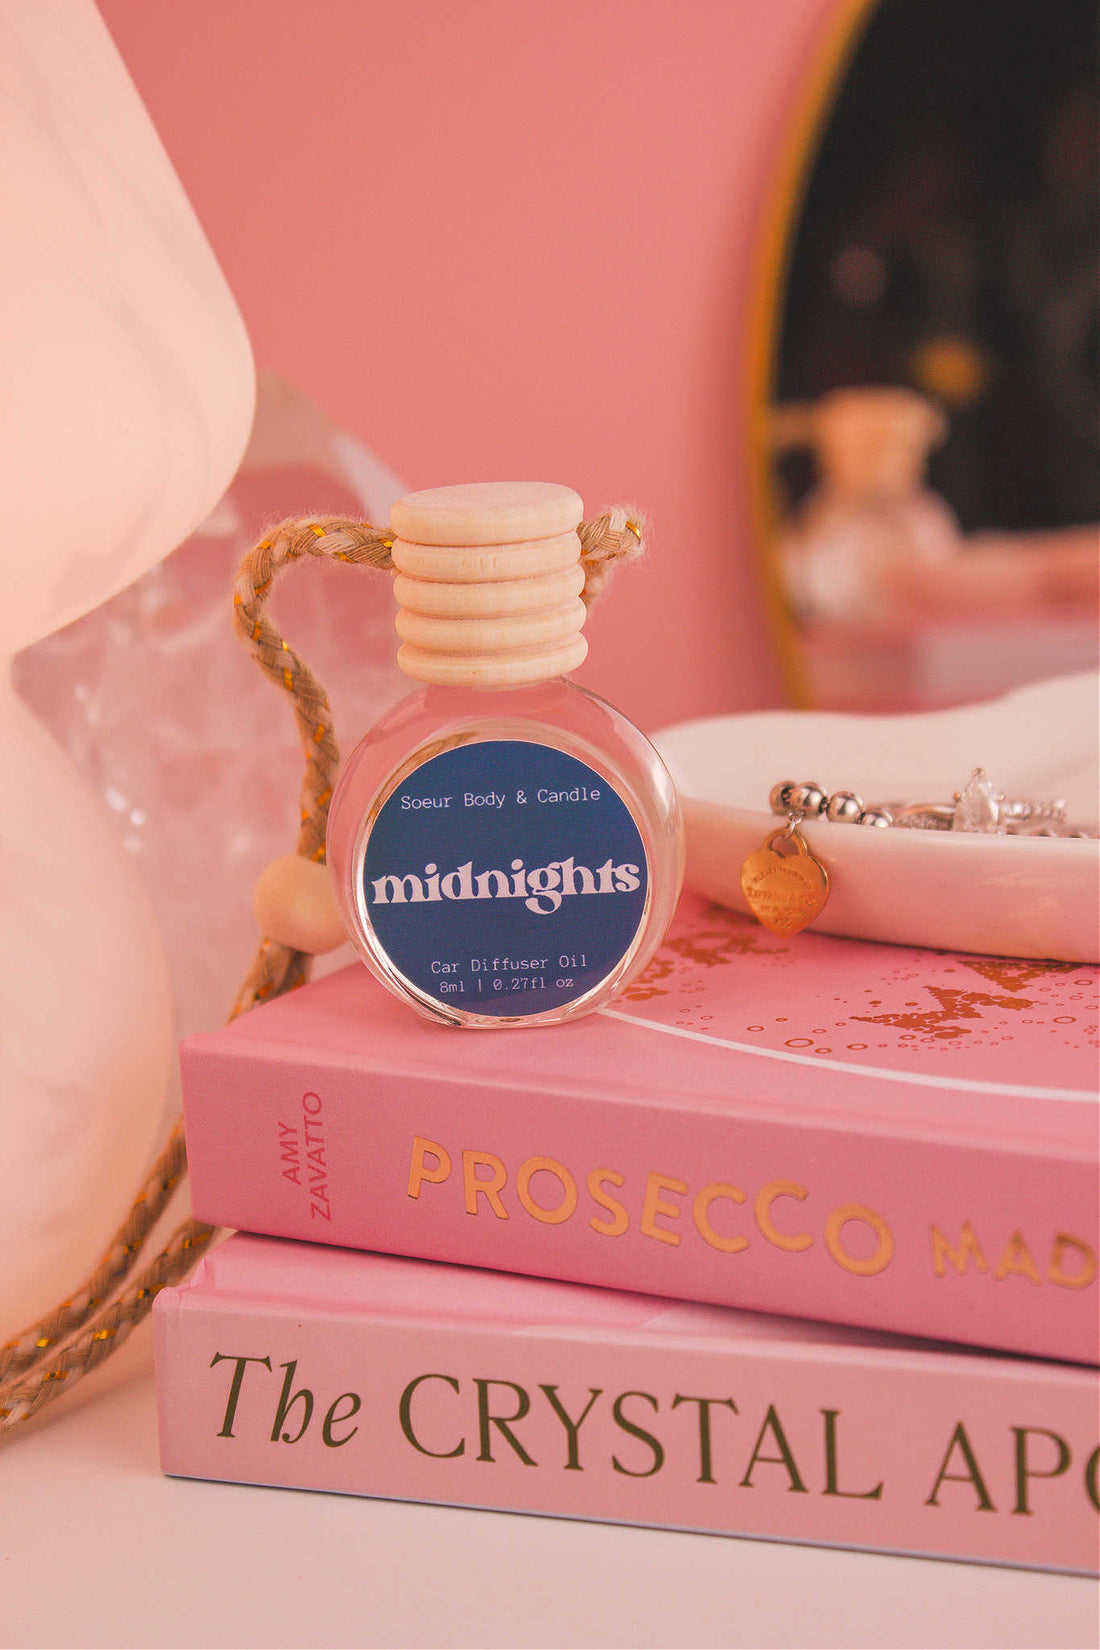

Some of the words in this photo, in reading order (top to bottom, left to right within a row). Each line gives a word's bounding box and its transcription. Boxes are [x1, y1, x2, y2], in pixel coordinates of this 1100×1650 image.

[401, 794, 453, 810] Soeur
[464, 793, 506, 808] Body
[516, 790, 528, 804] &
[537, 787, 601, 803] Candle
[371, 856, 641, 915] midnights
[431, 960, 461, 974] Car
[471, 957, 549, 972] Diffuser
[559, 954, 588, 968] Oil
[440, 980, 465, 993] 8ml
[493, 976, 546, 991] 0.27fl
[556, 978, 574, 988] oz
[278, 1121, 302, 1186] AMY
[302, 1091, 332, 1222] ZAVATTO
[407, 1135, 895, 1277] PROSECCO
[930, 1219, 1098, 1290] MAD
[209, 1351, 362, 1448] The
[399, 1372, 885, 1500] CRYSTAL
[925, 1420, 1099, 1517] AP
